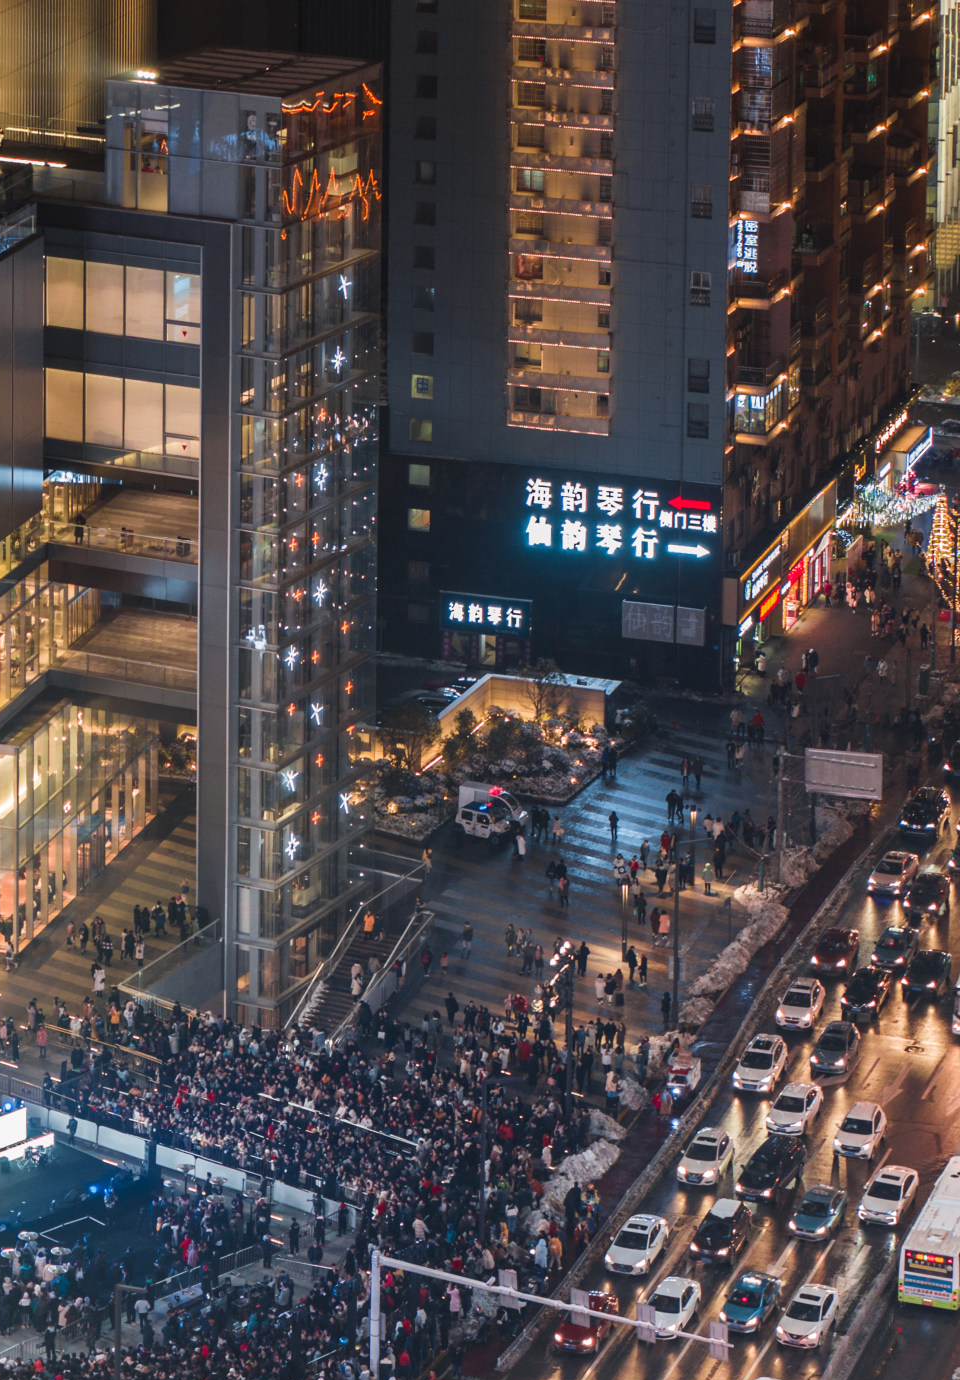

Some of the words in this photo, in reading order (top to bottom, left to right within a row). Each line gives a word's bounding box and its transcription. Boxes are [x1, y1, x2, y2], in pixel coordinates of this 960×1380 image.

[525, 478, 660, 520] 海韵琴行
[525, 515, 659, 559] 仙韵琴行
[658, 510, 717, 534] 侧门三楼
[448, 602, 523, 628] 海韵琴行
